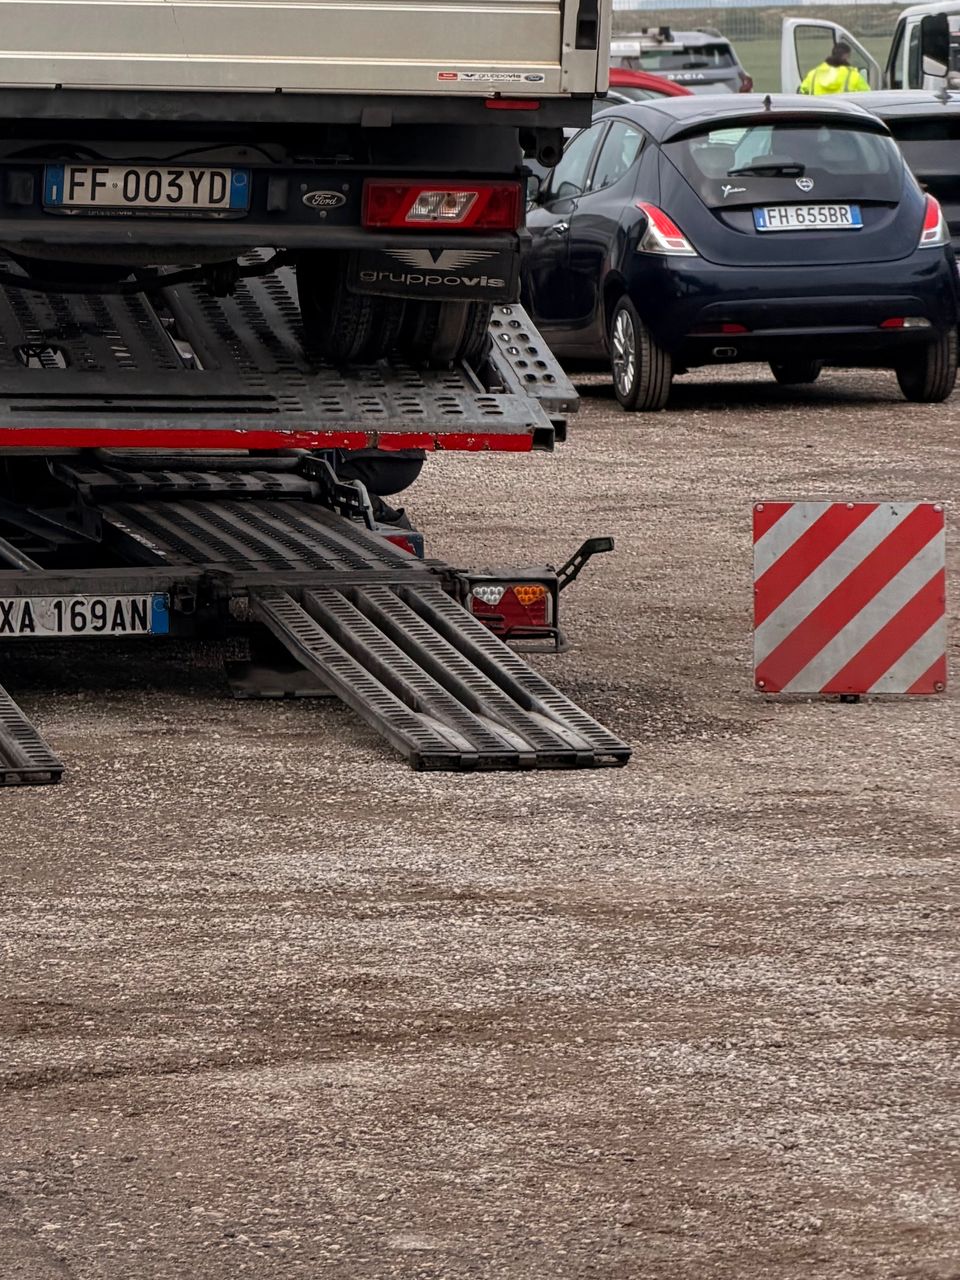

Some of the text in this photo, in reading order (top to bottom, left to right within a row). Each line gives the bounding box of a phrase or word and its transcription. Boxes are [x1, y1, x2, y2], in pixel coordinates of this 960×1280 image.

[68, 167, 227, 204] FF 003YD
[311, 194, 338, 205] Ford
[767, 206, 850, 225] FH 655BR
[359, 270, 506, 288] gruppovis
[53, 598, 148, 632] 169AN
